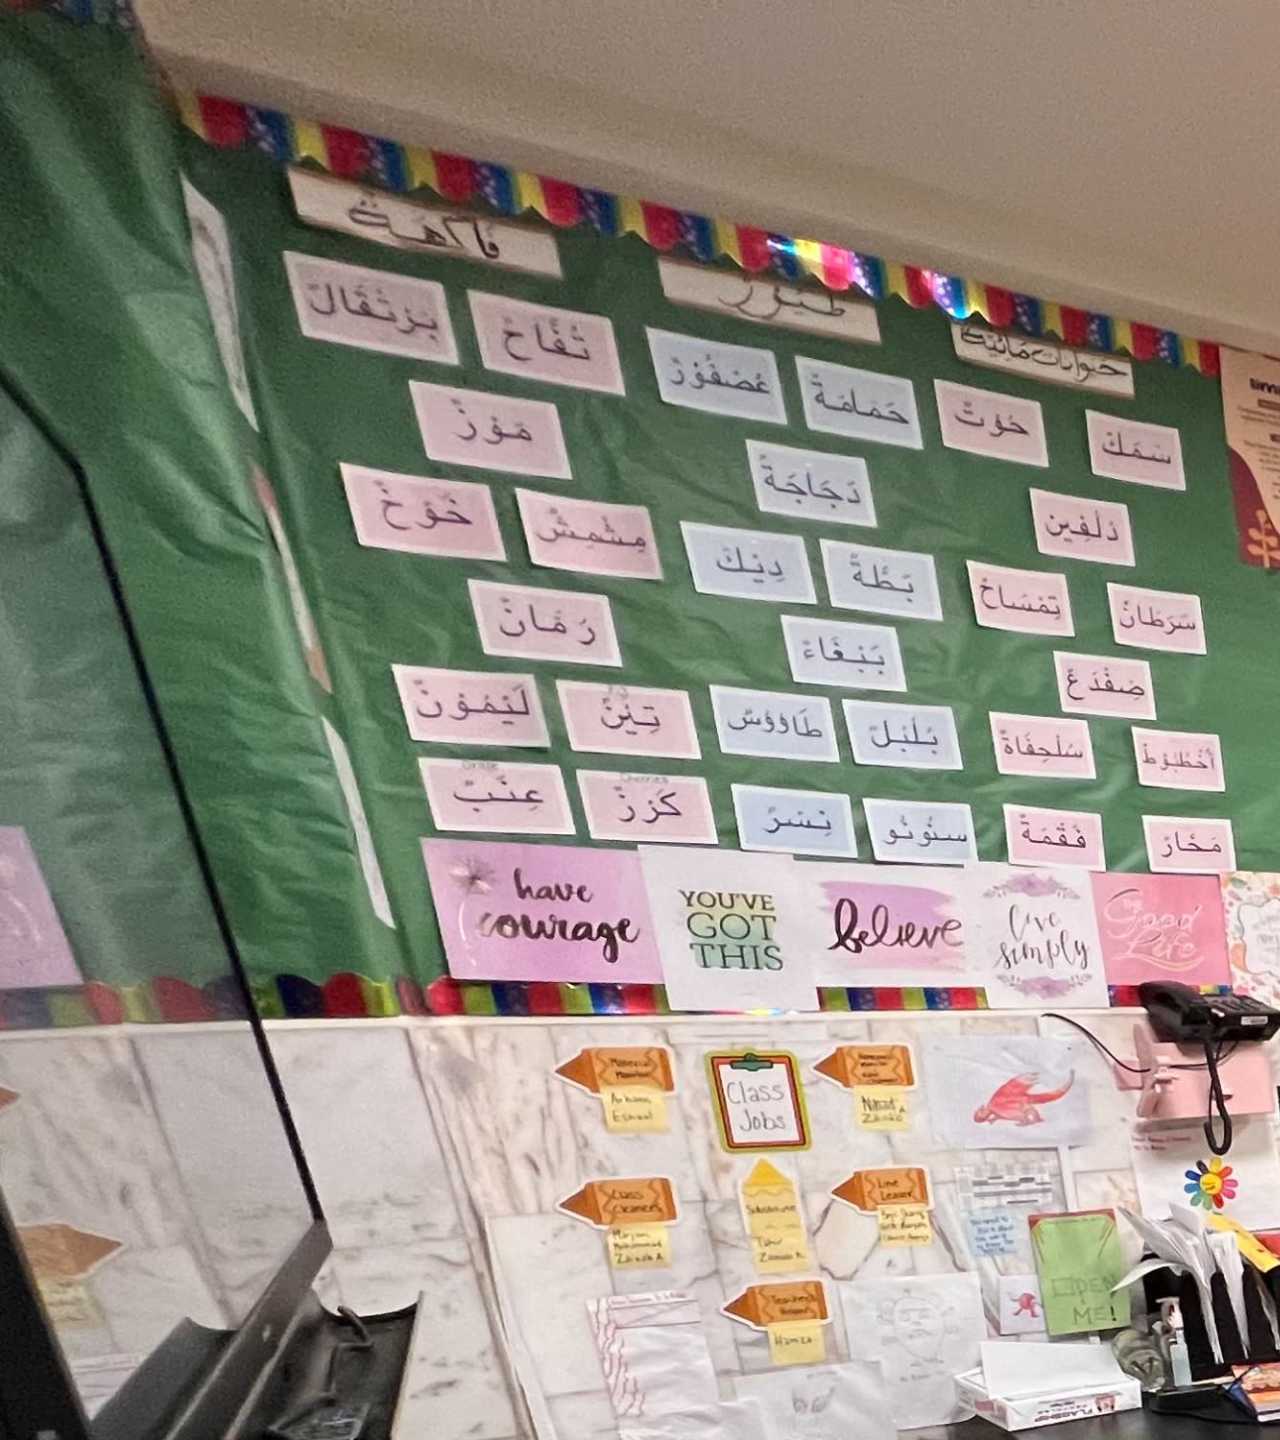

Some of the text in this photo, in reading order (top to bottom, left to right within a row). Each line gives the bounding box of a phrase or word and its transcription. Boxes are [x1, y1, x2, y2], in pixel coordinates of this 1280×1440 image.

[513, 868, 593, 903] have
[679, 890, 775, 912] YOU'VE
[478, 913, 641, 962] courage
[686, 913, 777, 942] GOT
[828, 898, 964, 953] believe
[689, 942, 784, 971] THIS
[993, 930, 1091, 970] simply
[726, 1081, 785, 1103] Class
[740, 1110, 786, 1133] Jobs
[1073, 1305, 1117, 1326] ME!
